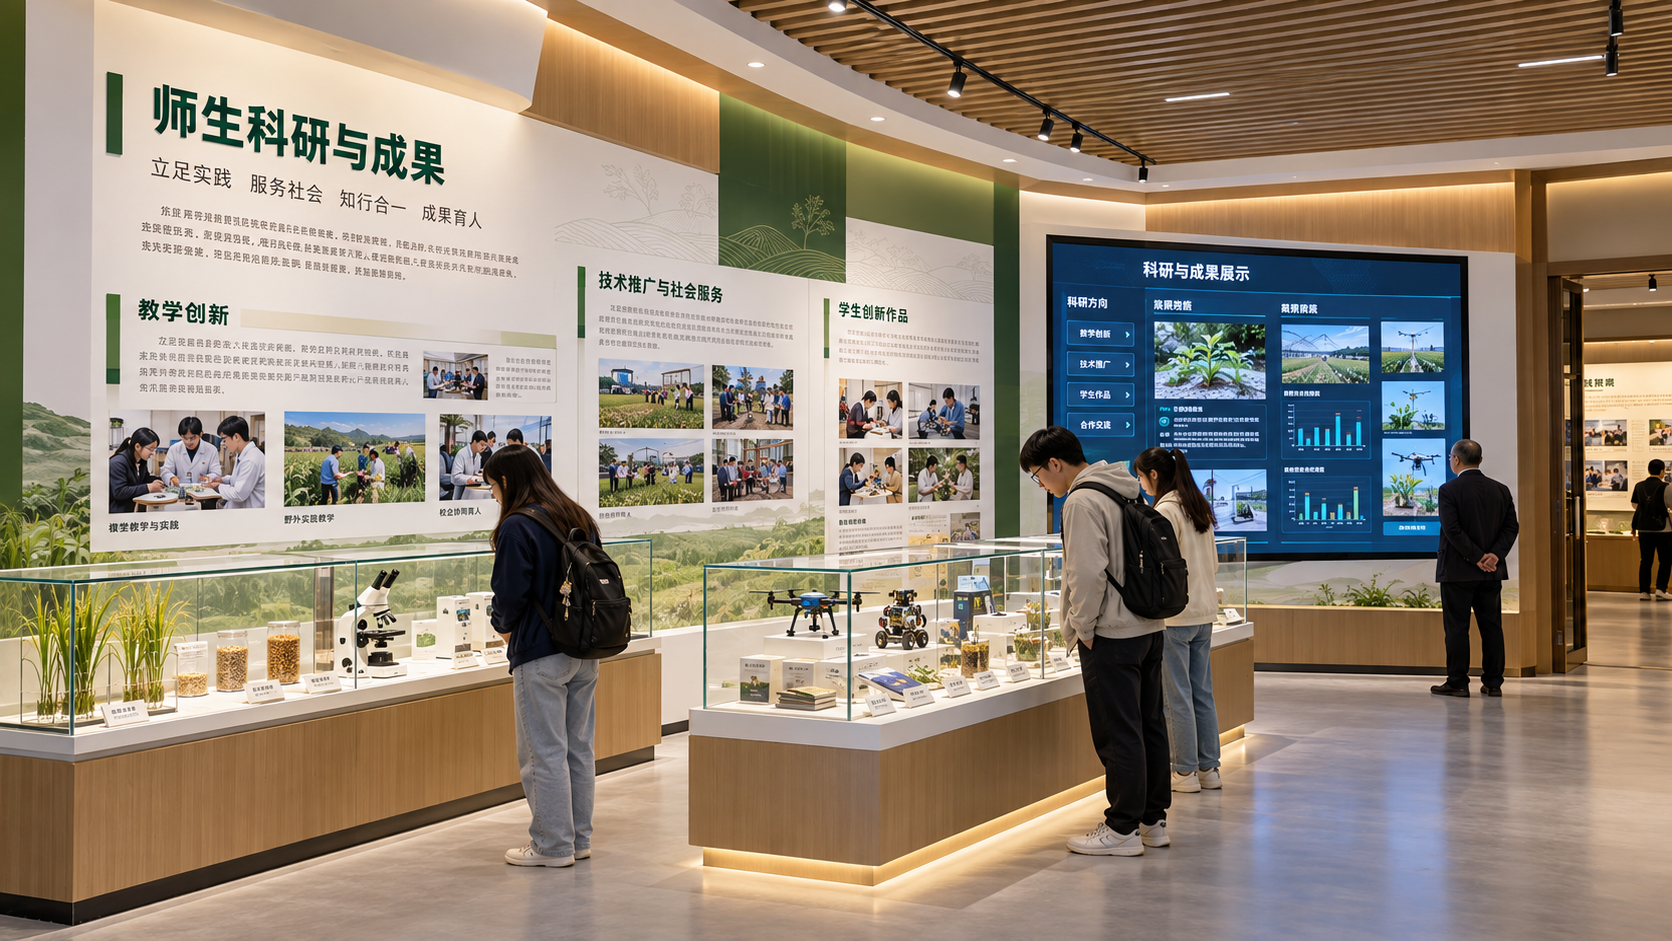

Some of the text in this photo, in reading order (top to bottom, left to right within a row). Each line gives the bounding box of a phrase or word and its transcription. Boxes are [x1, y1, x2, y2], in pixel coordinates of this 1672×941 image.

[152, 84, 446, 186] 师生科研与成果
[150, 156, 483, 230] 立足实践 服务社会 知行合一 成果育人
[1142, 260, 1250, 282] 科研与成果展示
[598, 270, 723, 304] 技术推广与社会服务
[137, 298, 230, 326] 教学创新
[838, 301, 909, 324] 学生创新作品
[1066, 295, 1108, 310] 科研方向
